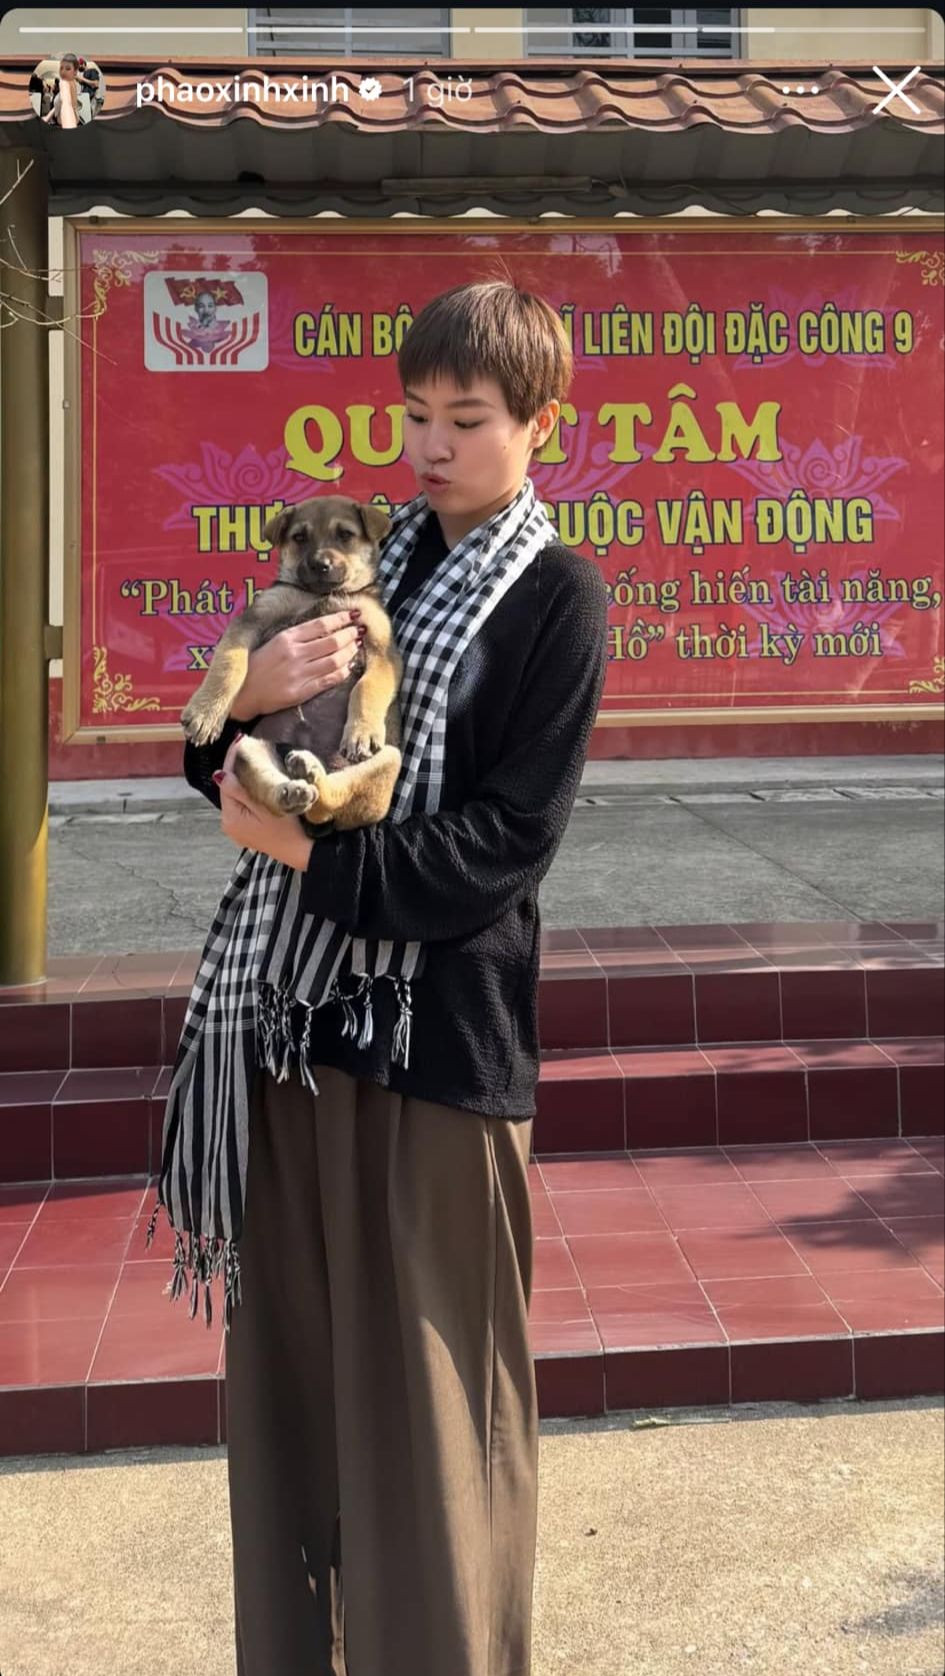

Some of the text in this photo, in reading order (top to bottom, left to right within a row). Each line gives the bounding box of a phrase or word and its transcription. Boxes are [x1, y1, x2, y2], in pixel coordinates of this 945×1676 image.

[294, 304, 363, 357] CÁN
[583, 303, 654, 356] LIÊN
[662, 301, 716, 364] ĐỘI
[724, 302, 790, 364] ĐẶC
[799, 302, 885, 355] CÔNG
[893, 309, 914, 355] 9
[597, 382, 784, 464] TÂM
[541, 489, 645, 556] UỘC
[655, 490, 744, 555] VẬN
[755, 488, 874, 555] ĐỘNG
[120, 578, 235, 617] “Phát
[603, 565, 681, 613] ống
[690, 565, 772, 605] hiến
[782, 569, 830, 604] tài
[841, 569, 943, 611] năng,
[675, 622, 749, 660] thời
[760, 623, 804, 665] kỳ
[813, 621, 884, 657] mới
